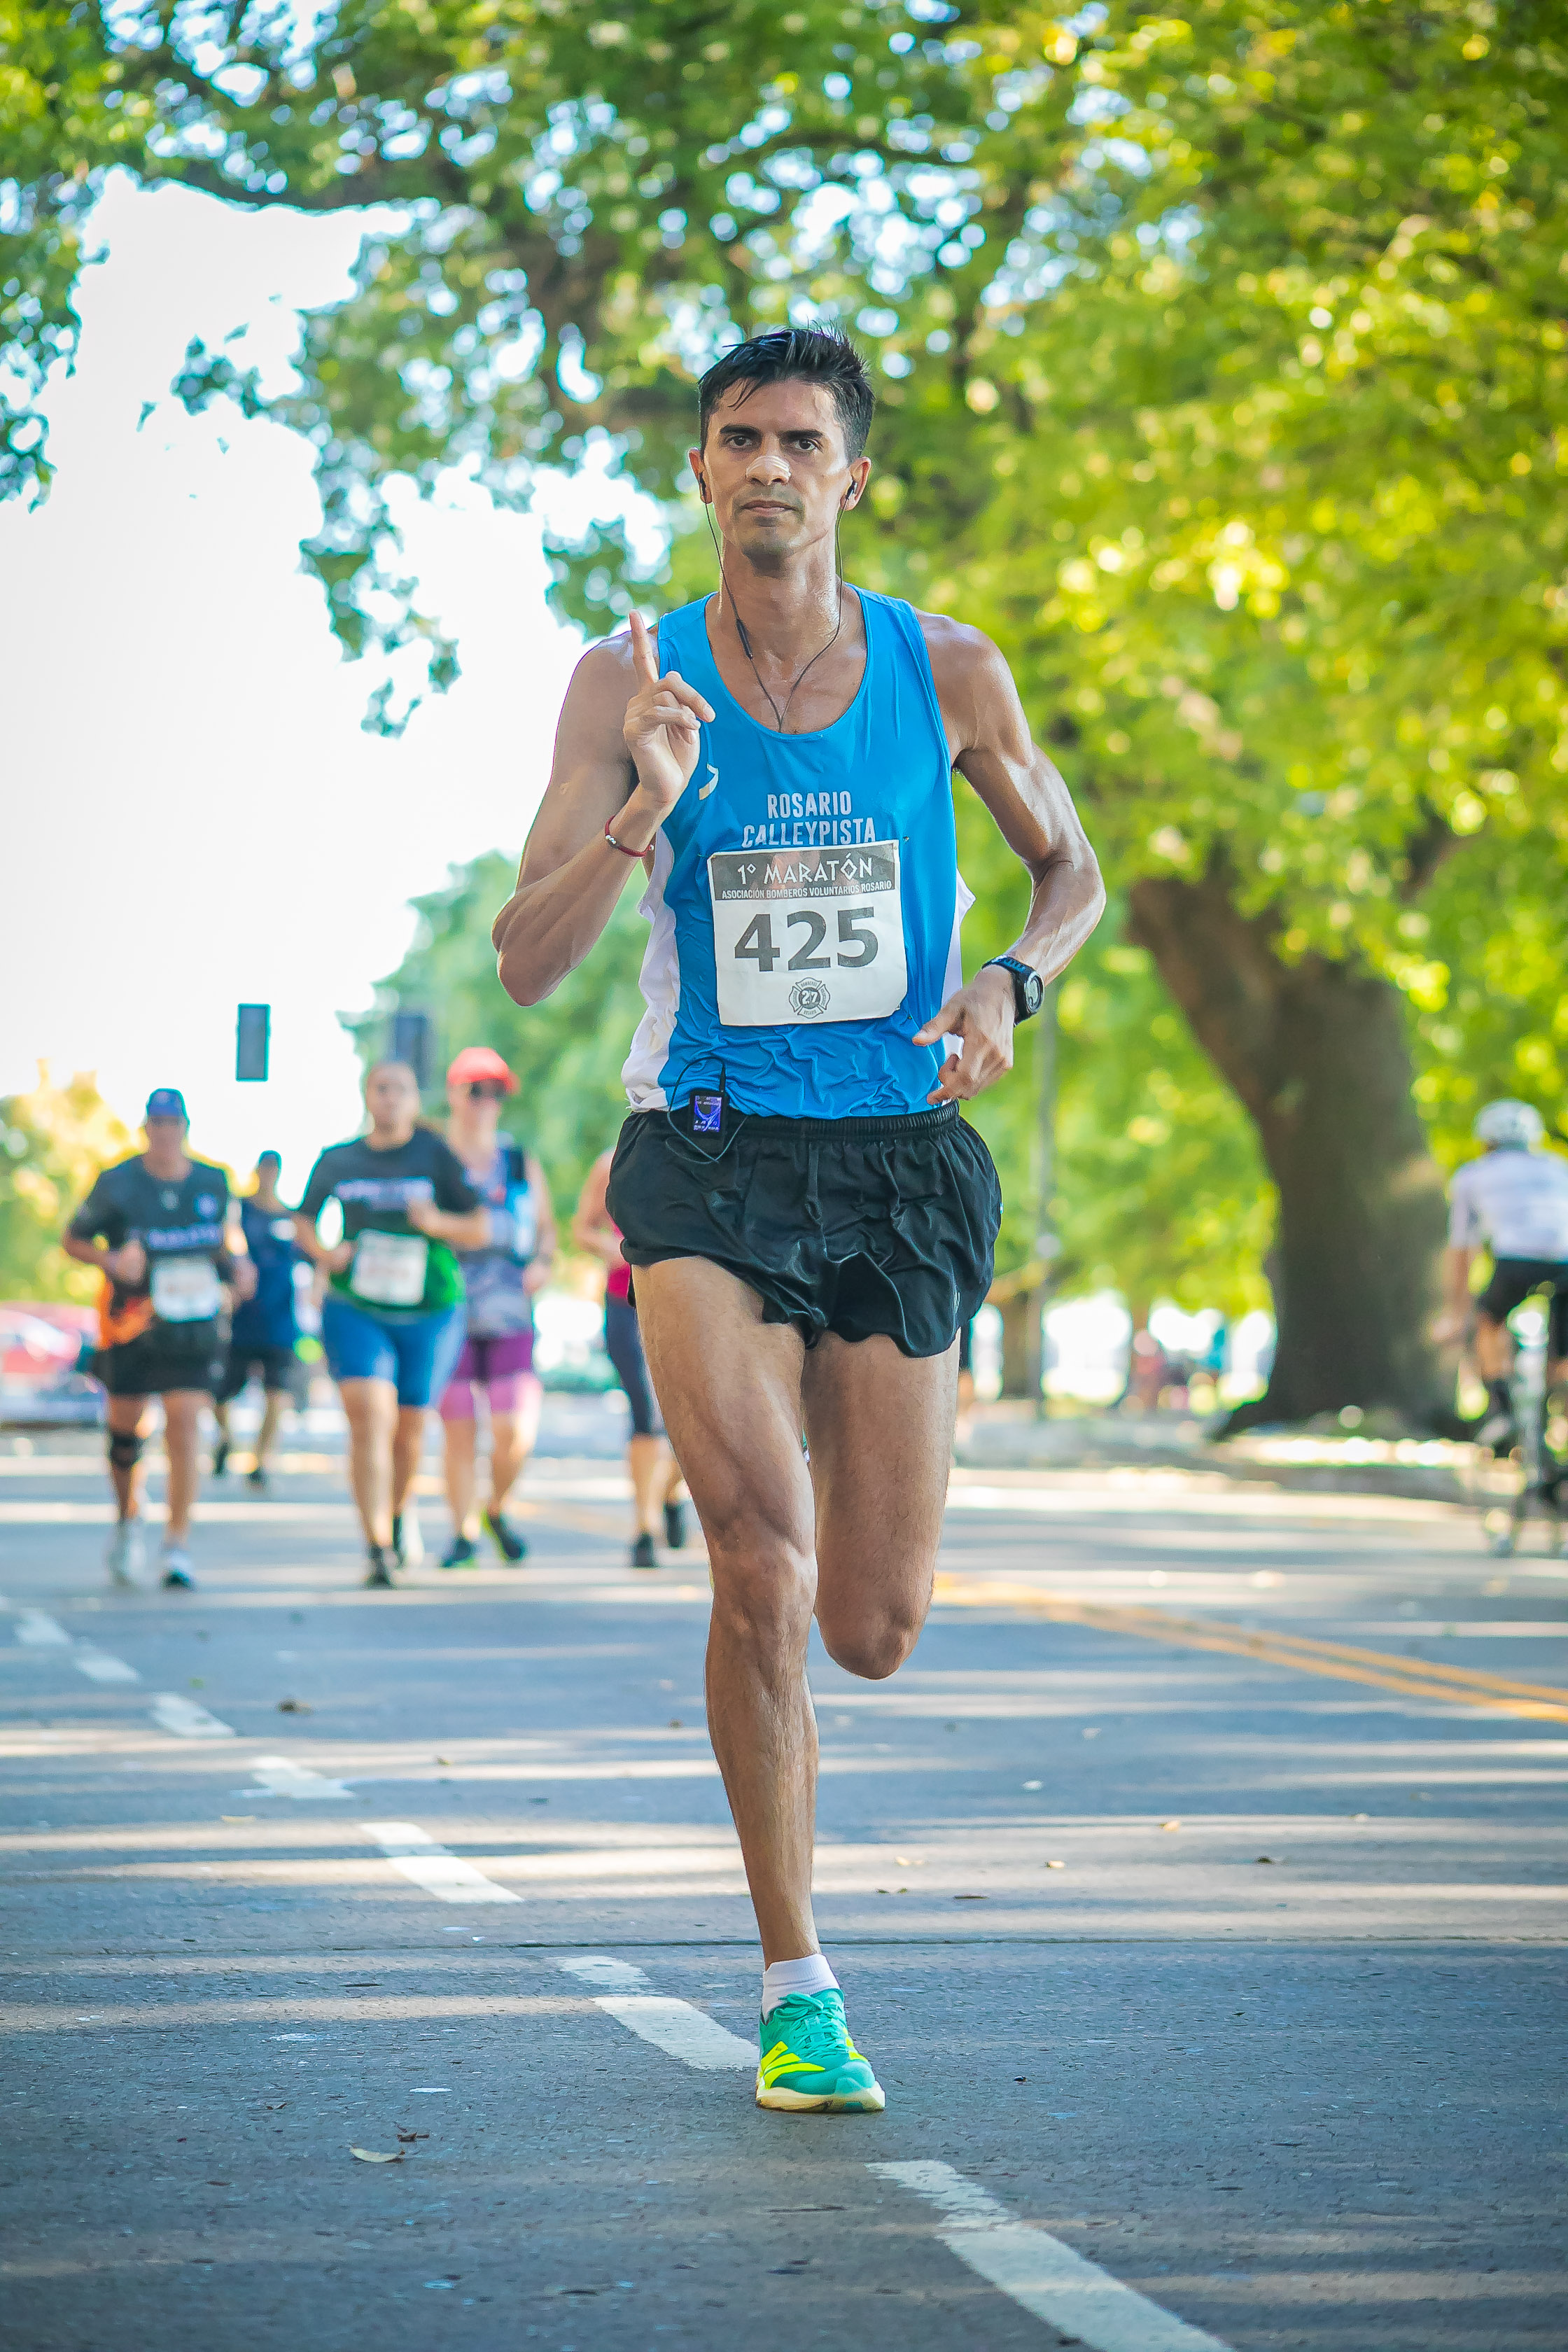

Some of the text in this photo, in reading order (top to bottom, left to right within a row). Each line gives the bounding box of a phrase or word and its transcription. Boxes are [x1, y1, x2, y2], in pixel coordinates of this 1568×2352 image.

[767, 791, 852, 819] ROSARIO
[741, 817, 876, 848] CALLEYPISTA
[763, 852, 872, 884] MARATÓN
[722, 880, 892, 899] ASOCIACIÓN BOMBEROS VOLUNTARIOS ROSARIO
[734, 906, 878, 972] 425
[801, 989, 818, 1006] 27
